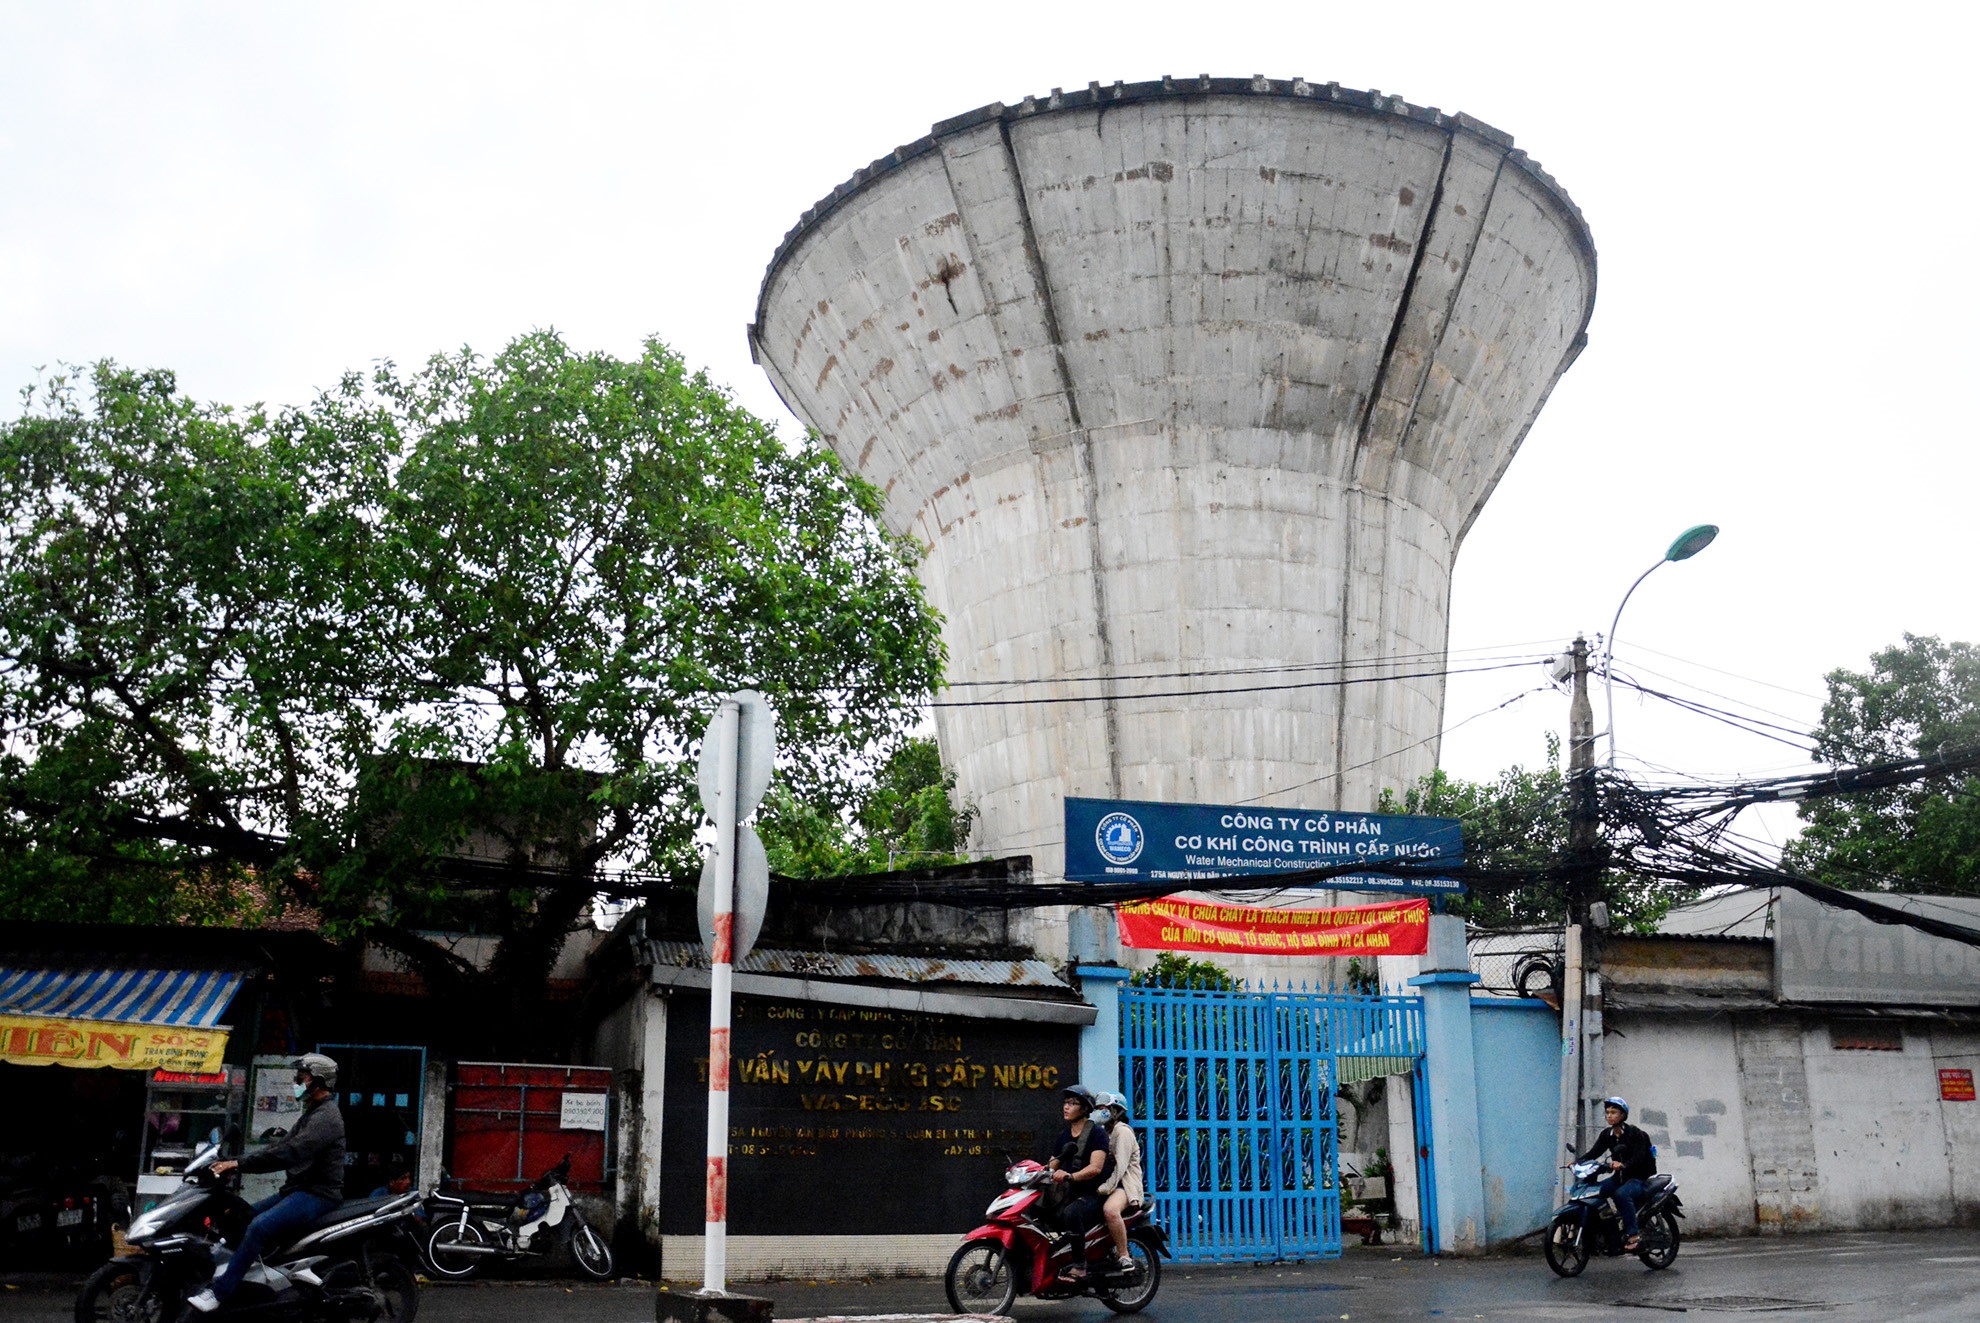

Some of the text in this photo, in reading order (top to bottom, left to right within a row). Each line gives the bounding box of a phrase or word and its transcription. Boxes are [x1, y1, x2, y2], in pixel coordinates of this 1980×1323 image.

[1220, 812, 1381, 835] CÔNG TY CỔ PHẦN
[1174, 835, 1202, 849] CƠ
[1206, 834, 1238, 851] KHÍ
[1241, 835, 1294, 852] CÔNG
[1298, 838, 1350, 855] TRÌNH
[1355, 838, 1390, 856] CẤP
[1185, 854, 1215, 866] Water
[1217, 855, 1272, 868] Mechanical
[1151, 900, 1175, 918] CHÁY
[1178, 901, 1191, 919] VÀ
[1161, 921, 1181, 943] CỦA
[1203, 928, 1216, 944] CƠ
[1217, 930, 1244, 948] QUAN,
[1245, 926, 1258, 946] TỔ
[1288, 931, 1301, 949] HỘ
[1301, 932, 1318, 947] GIA
[1318, 930, 1339, 948] ĐÌNH
[1341, 930, 1352, 947] VÀ
[1366, 929, 1391, 948] NHÂN
[0, 1023, 138, 1061] IÊN
[737, 1050, 790, 1086] VẤN
[935, 1055, 986, 1089] CẤP
[992, 1056, 1058, 1091] NƯỚC
